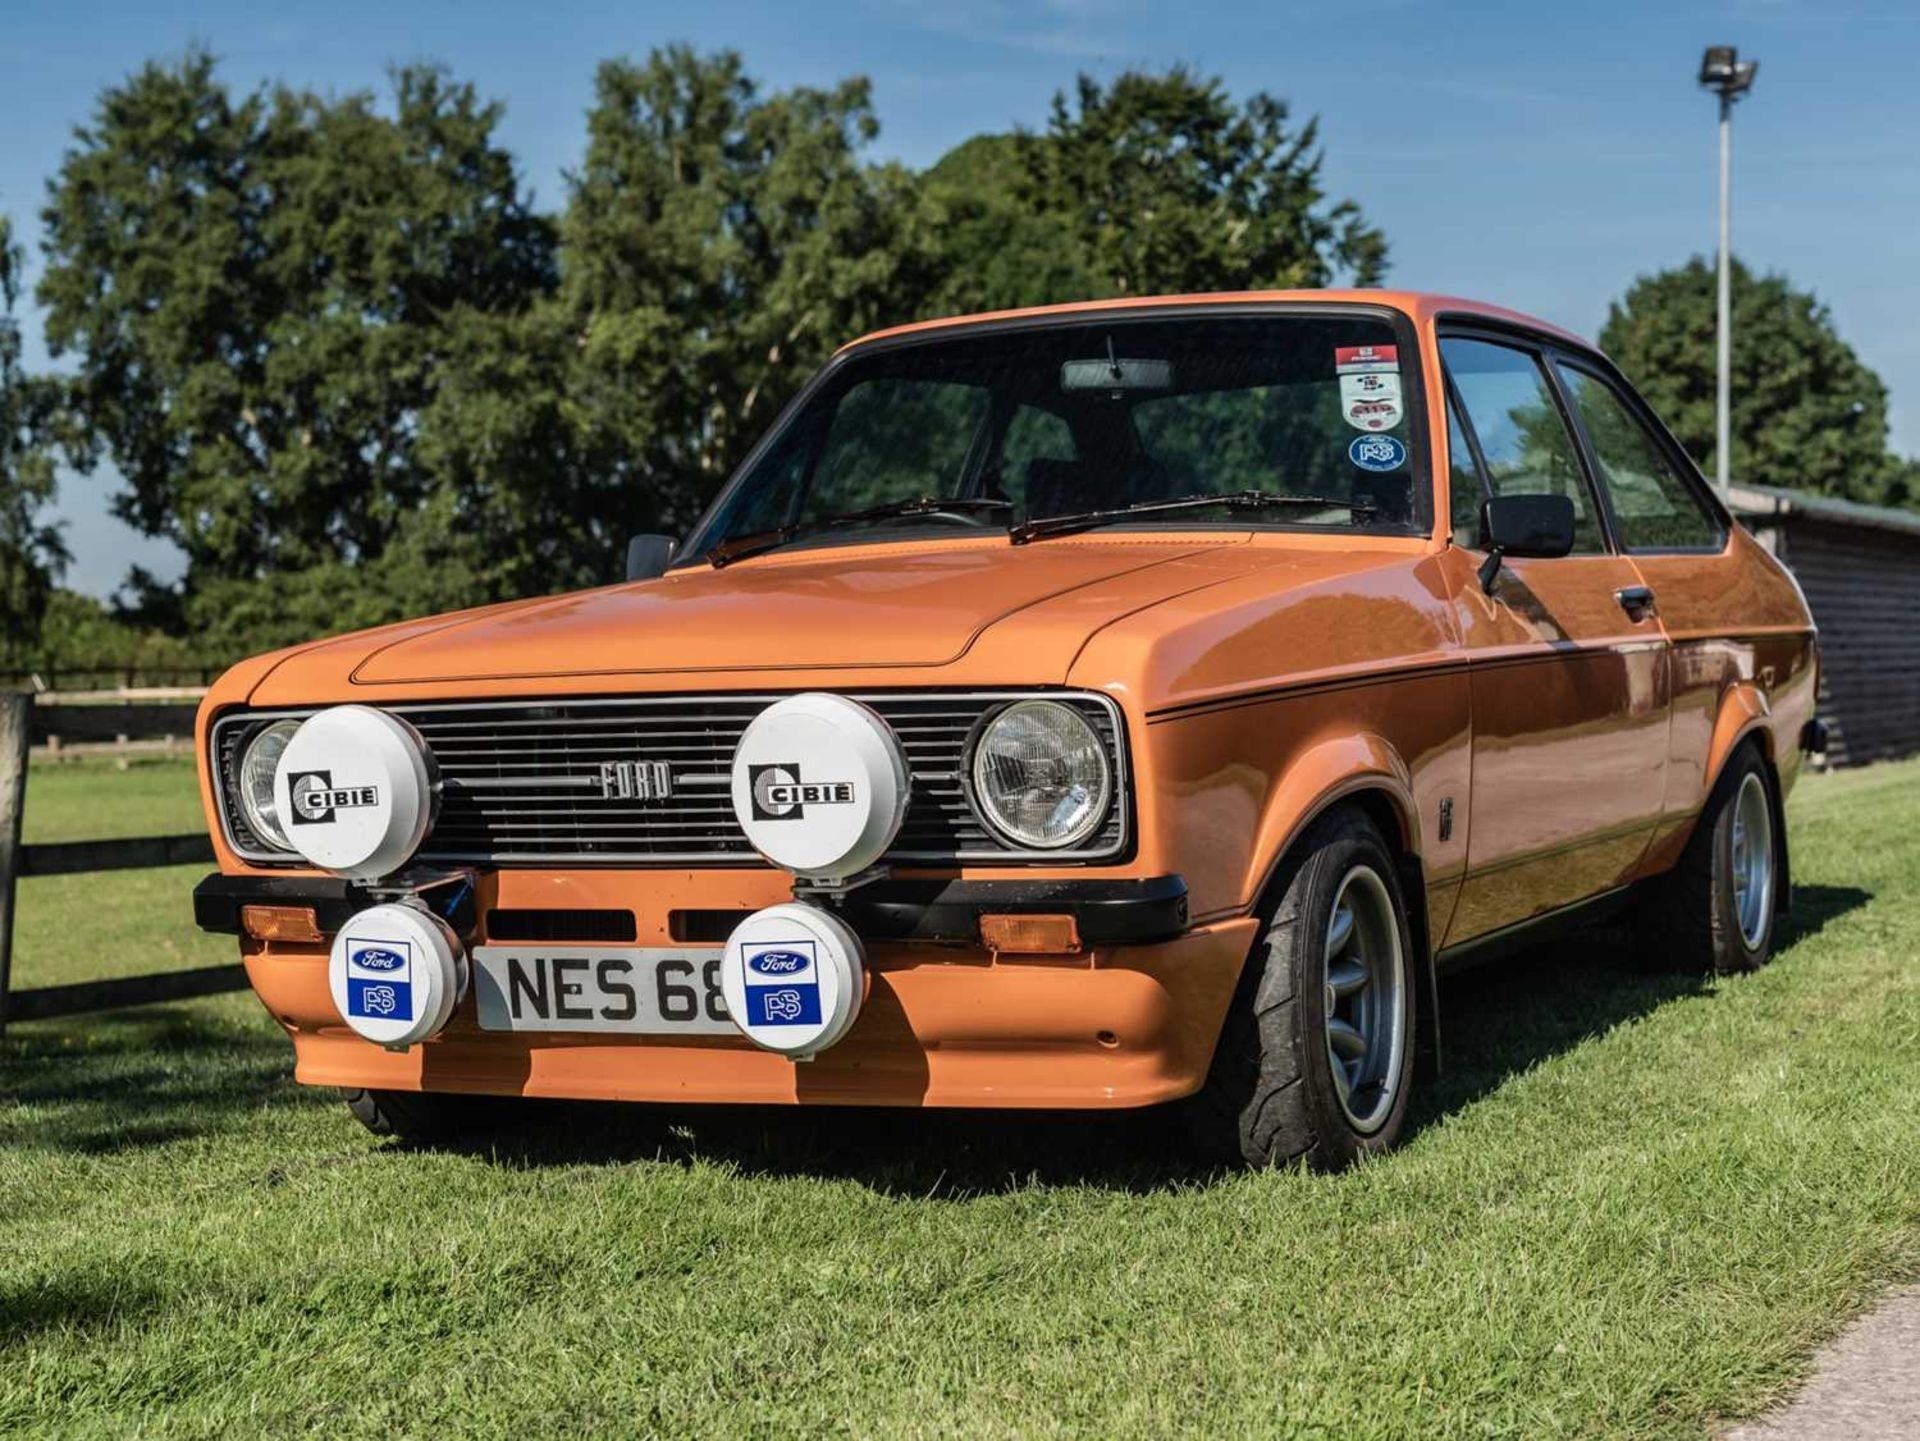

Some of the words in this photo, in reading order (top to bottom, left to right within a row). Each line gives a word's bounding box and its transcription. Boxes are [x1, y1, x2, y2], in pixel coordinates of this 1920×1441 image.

[600, 762, 671, 799] FORD
[361, 950, 395, 969] Ford
[760, 953, 798, 971] Ford
[363, 985, 396, 1014] RS
[507, 958, 637, 1021] NES
[764, 989, 802, 1020] RS
